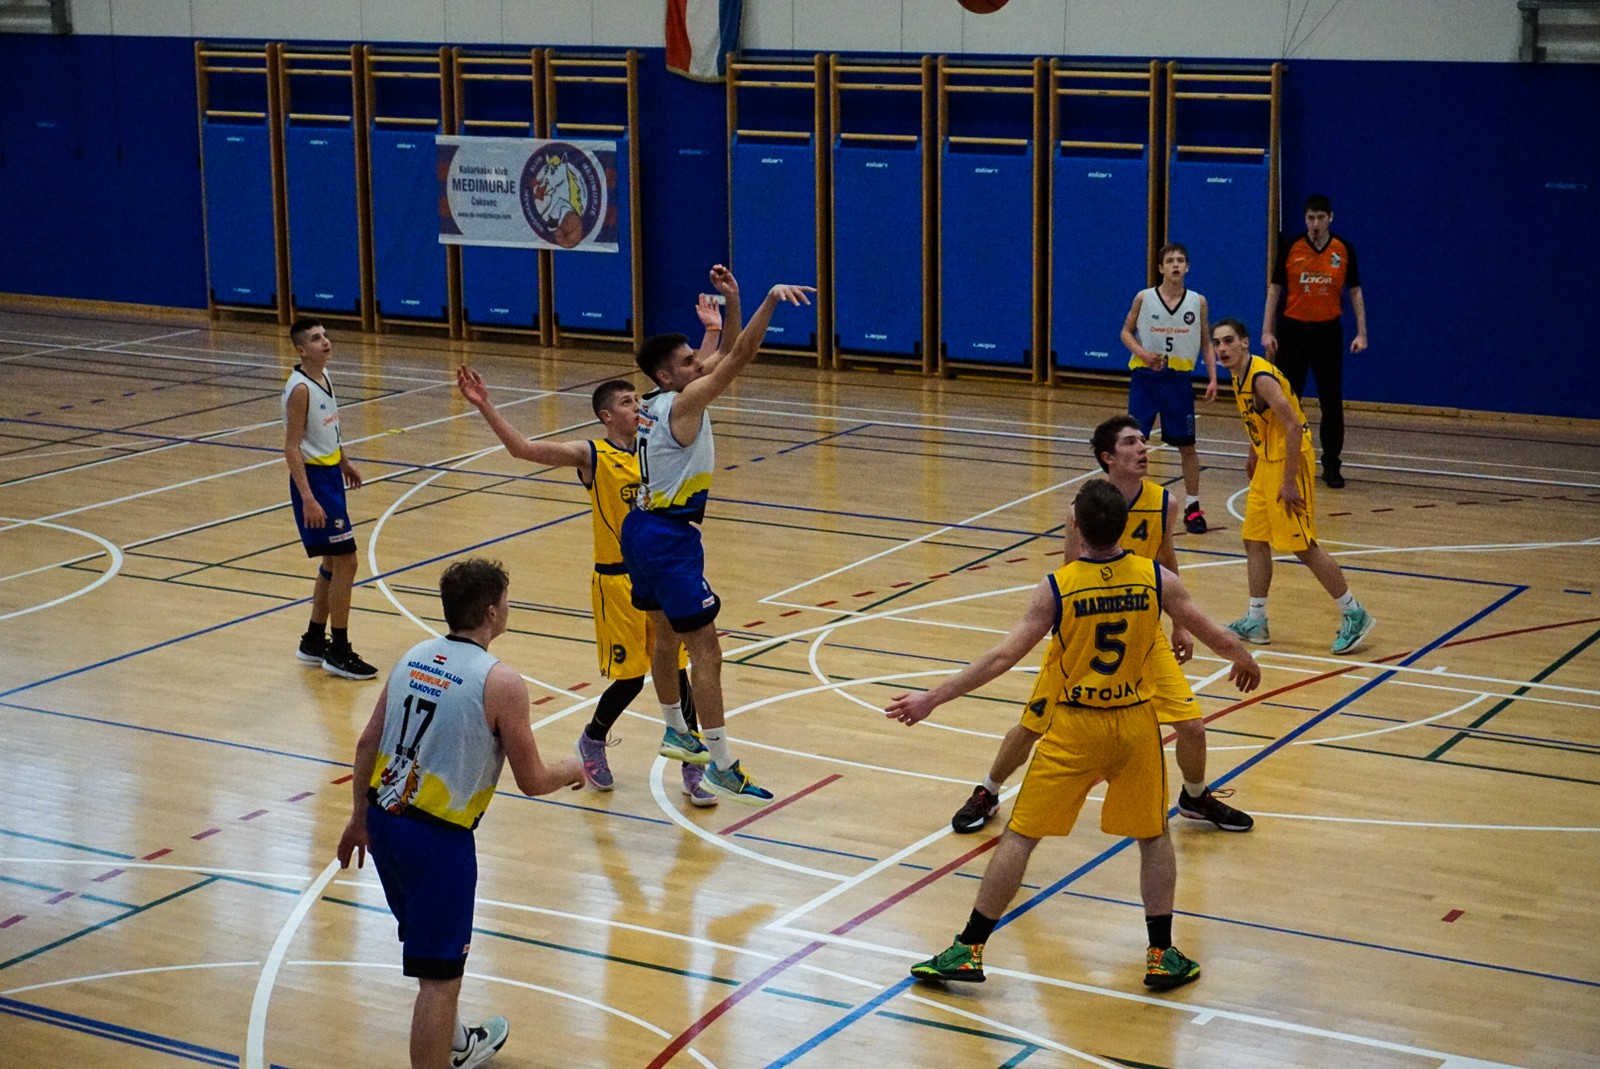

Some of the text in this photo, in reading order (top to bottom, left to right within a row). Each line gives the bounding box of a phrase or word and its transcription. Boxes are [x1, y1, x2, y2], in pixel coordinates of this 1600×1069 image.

[494, 167, 508, 176] klub
[1165, 336, 1174, 353] 5
[1131, 519, 1148, 541] 4
[1089, 618, 1128, 675] 5
[407, 660, 464, 686] KOŠARKAŠKI KLUB
[408, 678, 442, 698] ČAKOVEC
[1071, 682, 1135, 701] STOJA
[1029, 696, 1048, 718] 4
[395, 693, 438, 761] 17
